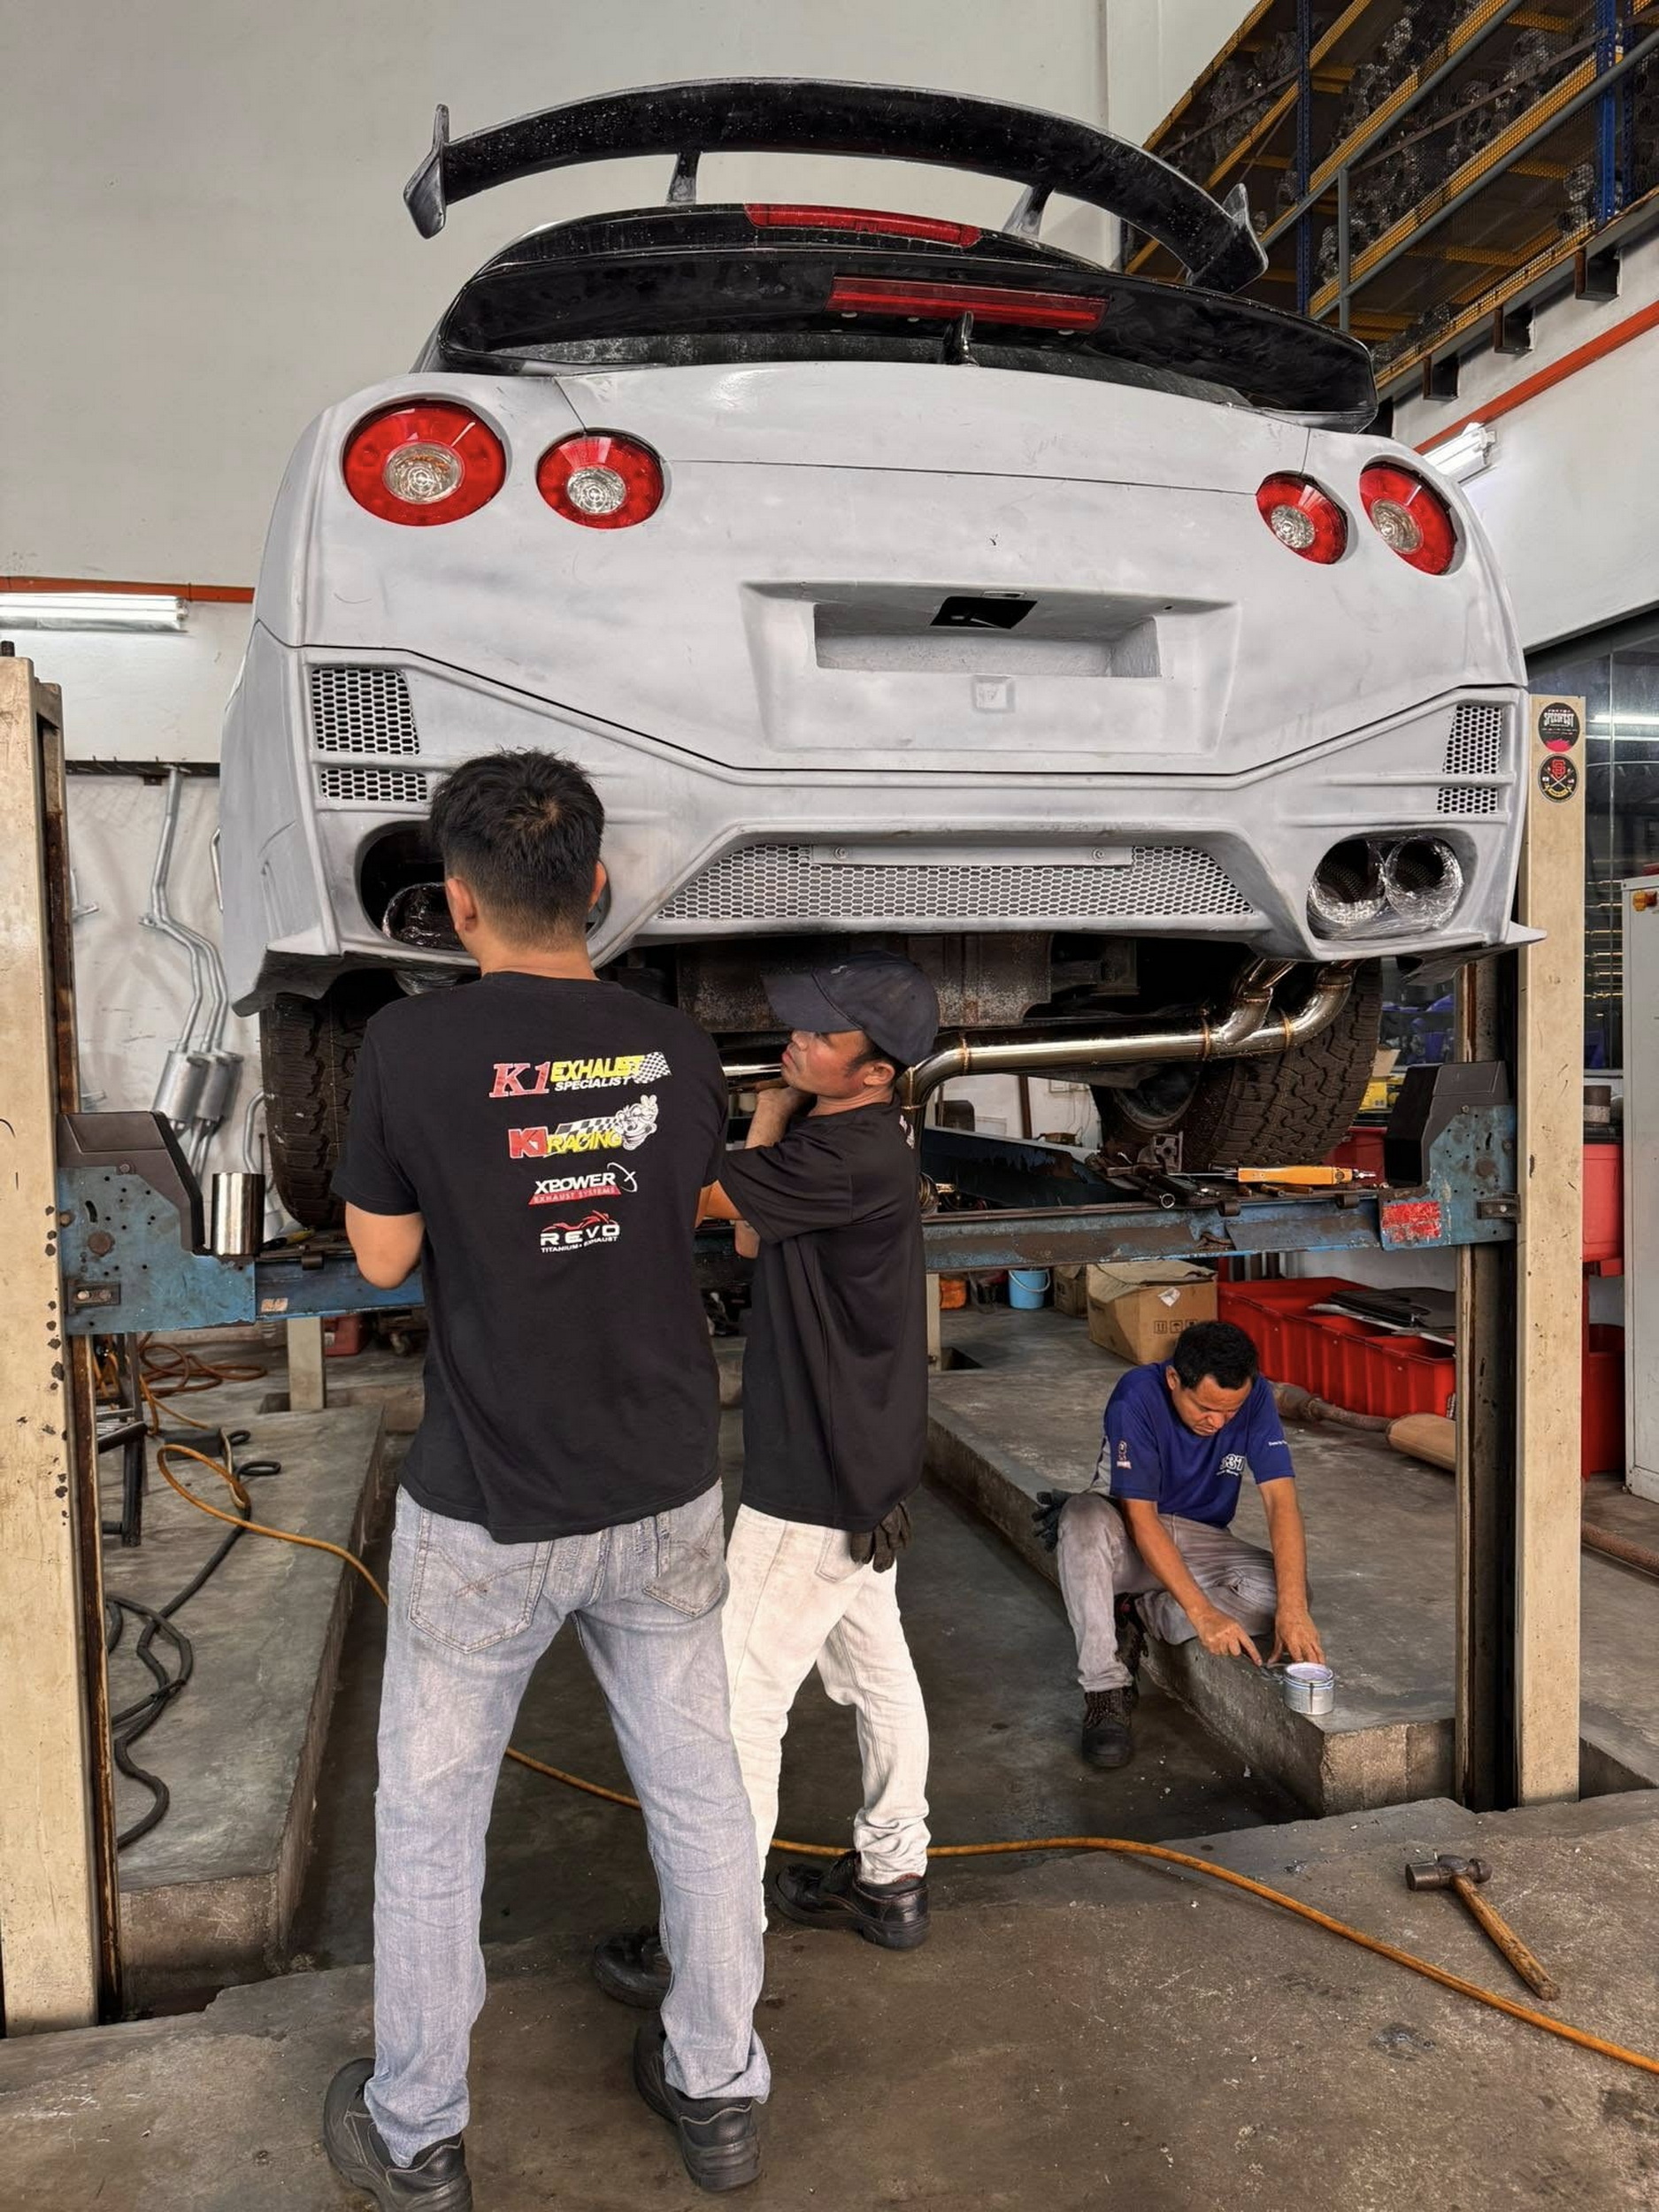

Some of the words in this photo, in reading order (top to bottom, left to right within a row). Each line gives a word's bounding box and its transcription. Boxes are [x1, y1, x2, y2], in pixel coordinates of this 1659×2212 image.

[489, 1062, 550, 1098] K1
[555, 1076, 632, 1091] SPECIALIST
[547, 1131, 622, 1154] RACING
[534, 1172, 616, 1194] XPOWER
[534, 1192, 576, 1203] EXHAUST
[578, 1187, 616, 1200] SYSTEMS
[541, 1225, 619, 1246] REVO
[541, 1243, 580, 1253] TITANIUM
